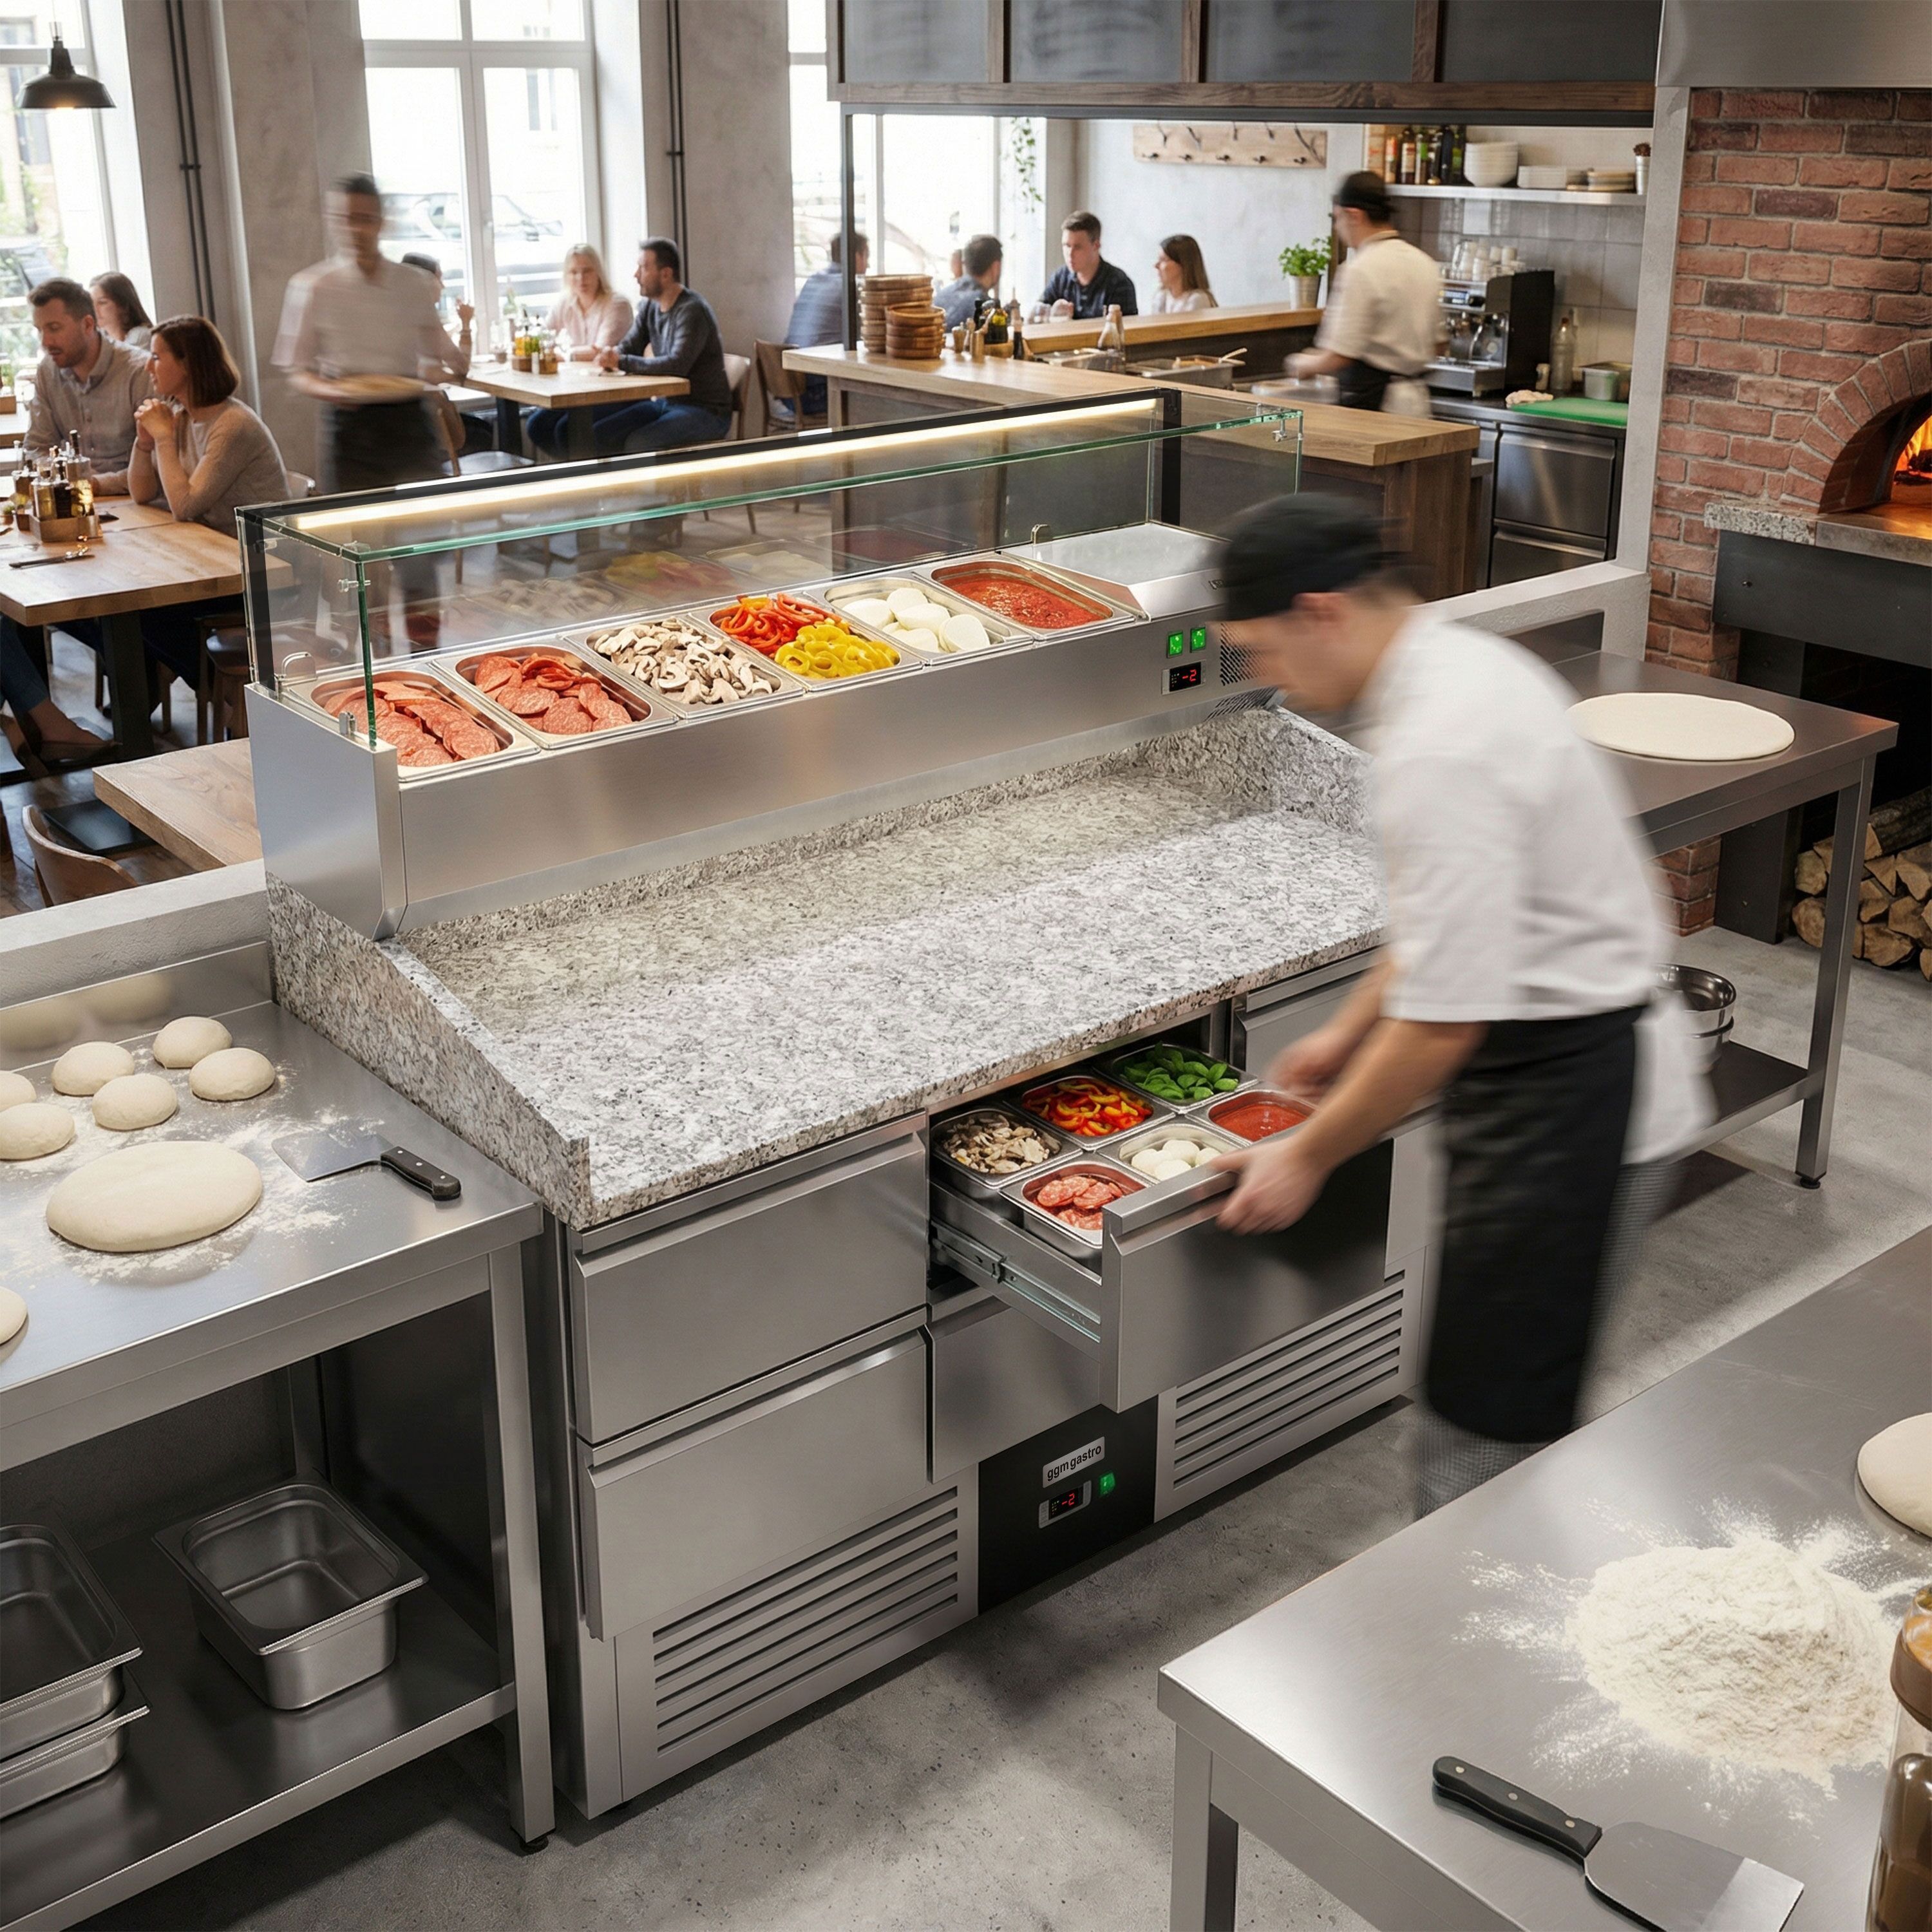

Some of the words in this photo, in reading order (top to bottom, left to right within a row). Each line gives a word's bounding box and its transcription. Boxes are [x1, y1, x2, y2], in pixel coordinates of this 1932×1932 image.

[1182, 669, 1197, 681] -2
[1047, 1461, 1069, 1481] ggm
[1070, 1446, 1101, 1470] gastro
[1061, 1493, 1075, 1506] -2
